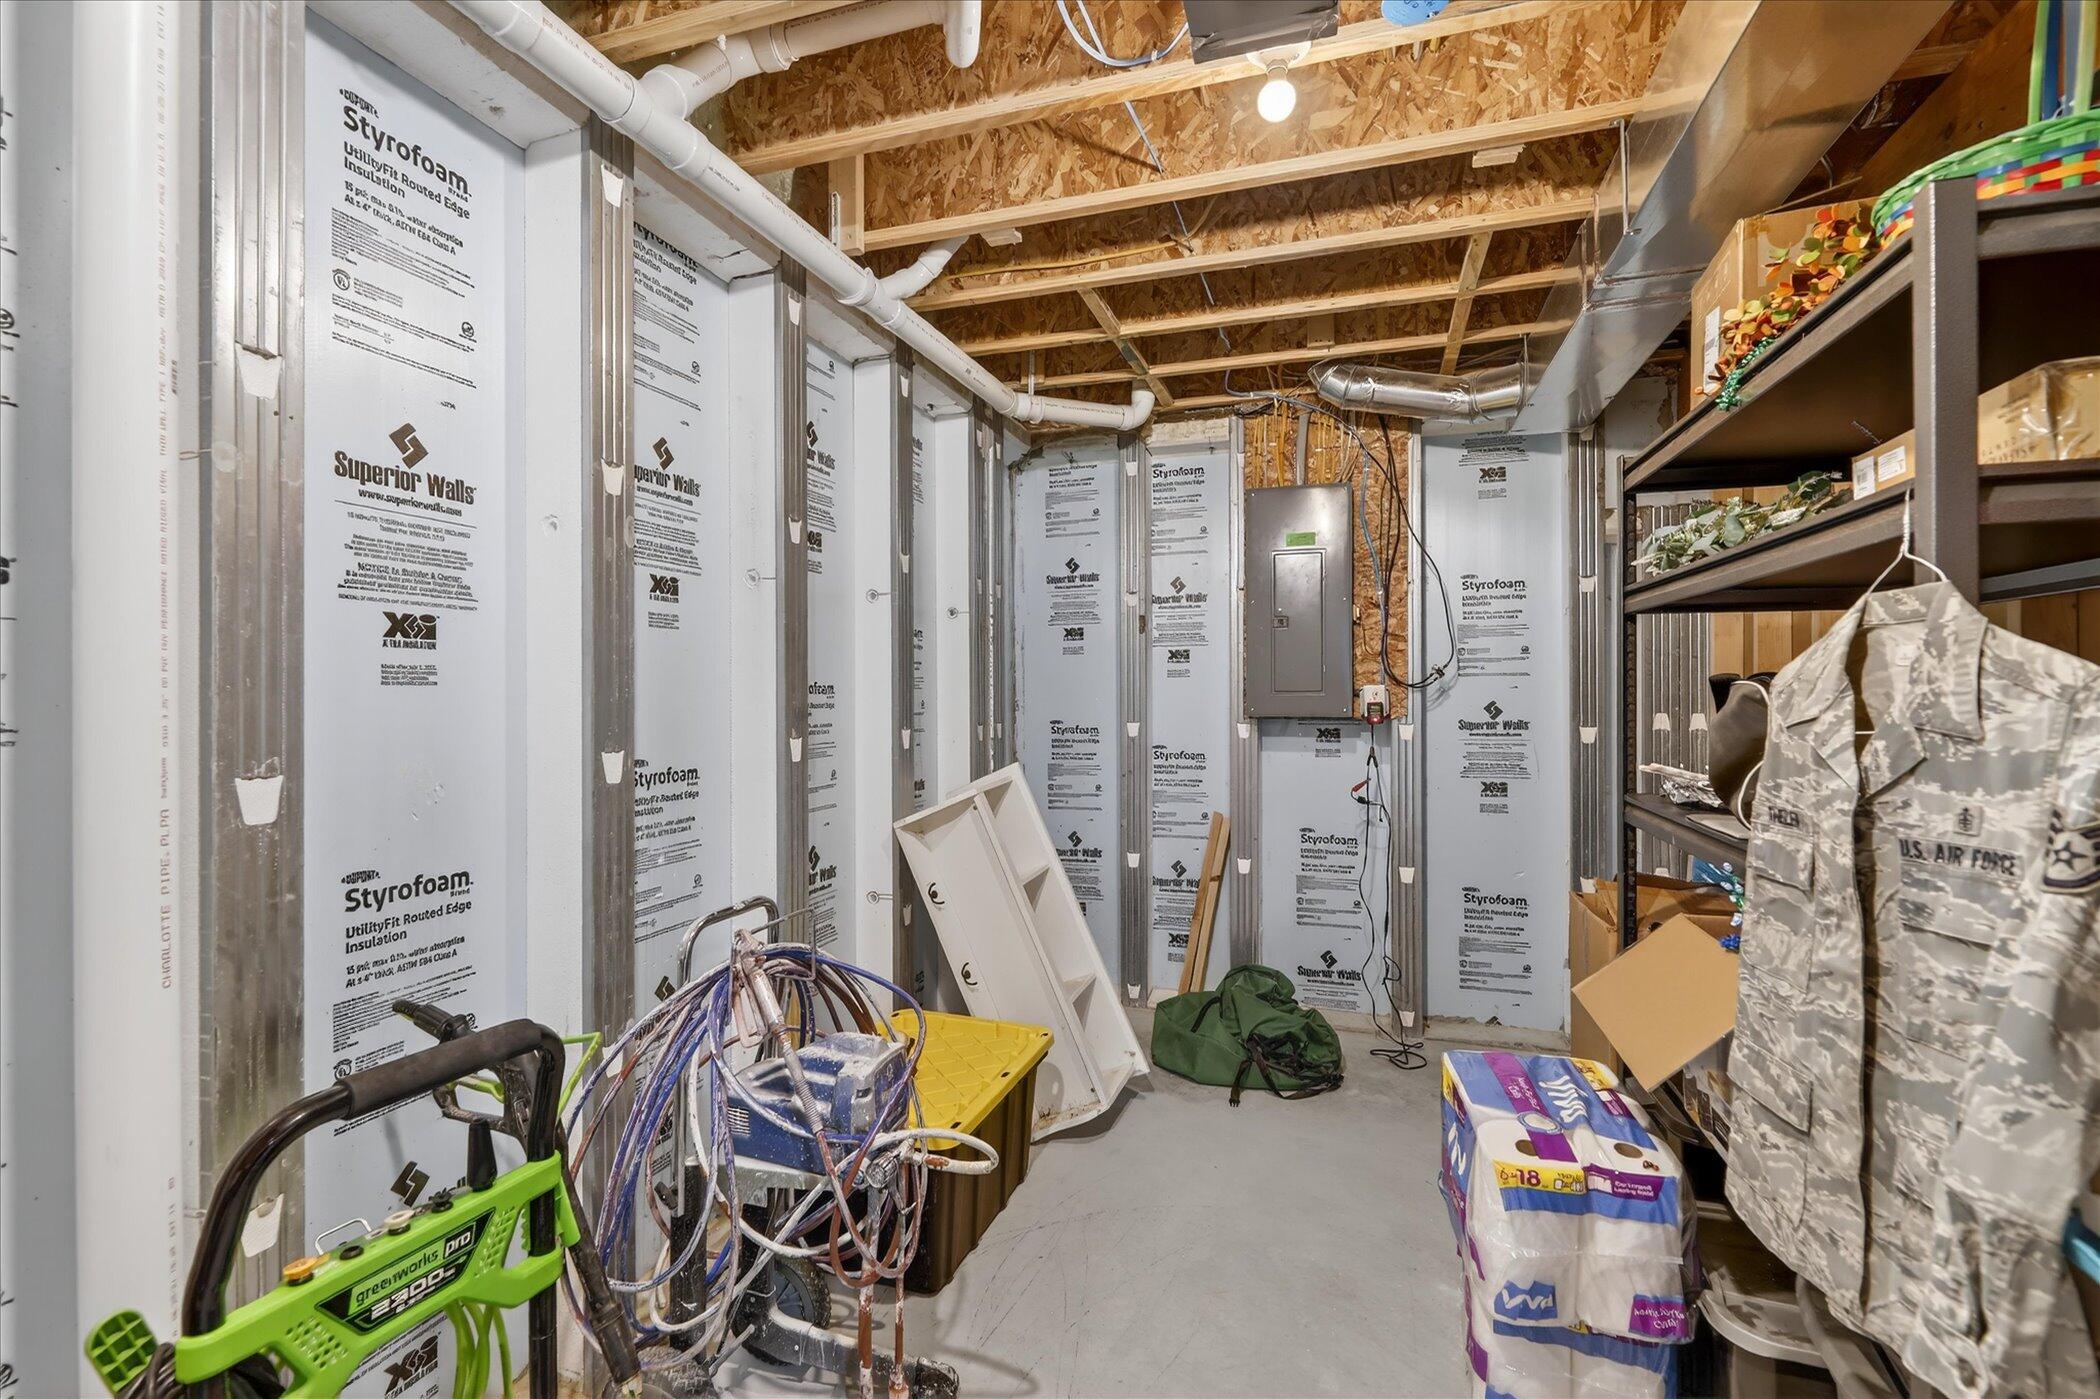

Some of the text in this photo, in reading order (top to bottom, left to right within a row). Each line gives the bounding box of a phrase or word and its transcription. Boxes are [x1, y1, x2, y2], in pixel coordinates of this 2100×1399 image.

[343, 105, 469, 195] Styrofoam
[344, 156, 406, 199] Insulation
[401, 172, 442, 204] Routed
[444, 196, 471, 219] Edge
[334, 450, 475, 506] Superior Walls
[672, 473, 701, 497] Walls
[1152, 466, 1205, 479] Styrofoam
[1461, 579, 1526, 593] Styrofoam
[1051, 724, 1099, 736] Styrofoam
[1458, 719, 1530, 732] Superior Walls
[1153, 750, 1206, 761] Styrofoam
[1300, 833, 1358, 846] Styrofoam
[1900, 838, 2017, 876] U.S. AIR FORCE
[160, 857, 171, 896] PIPE
[344, 871, 470, 912] Styrofoam
[1463, 893, 1528, 907] Styrofoam
[345, 900, 472, 939] UtilityFit Routed Edge
[160, 904, 172, 989] CHARLOTTE
[345, 931, 408, 954] Insulation
[1297, 965, 1362, 981] Superior Walls
[1515, 1168, 1541, 1187] 18
[355, 1231, 471, 1306] greenworks pro
[371, 1267, 445, 1320] 2300
